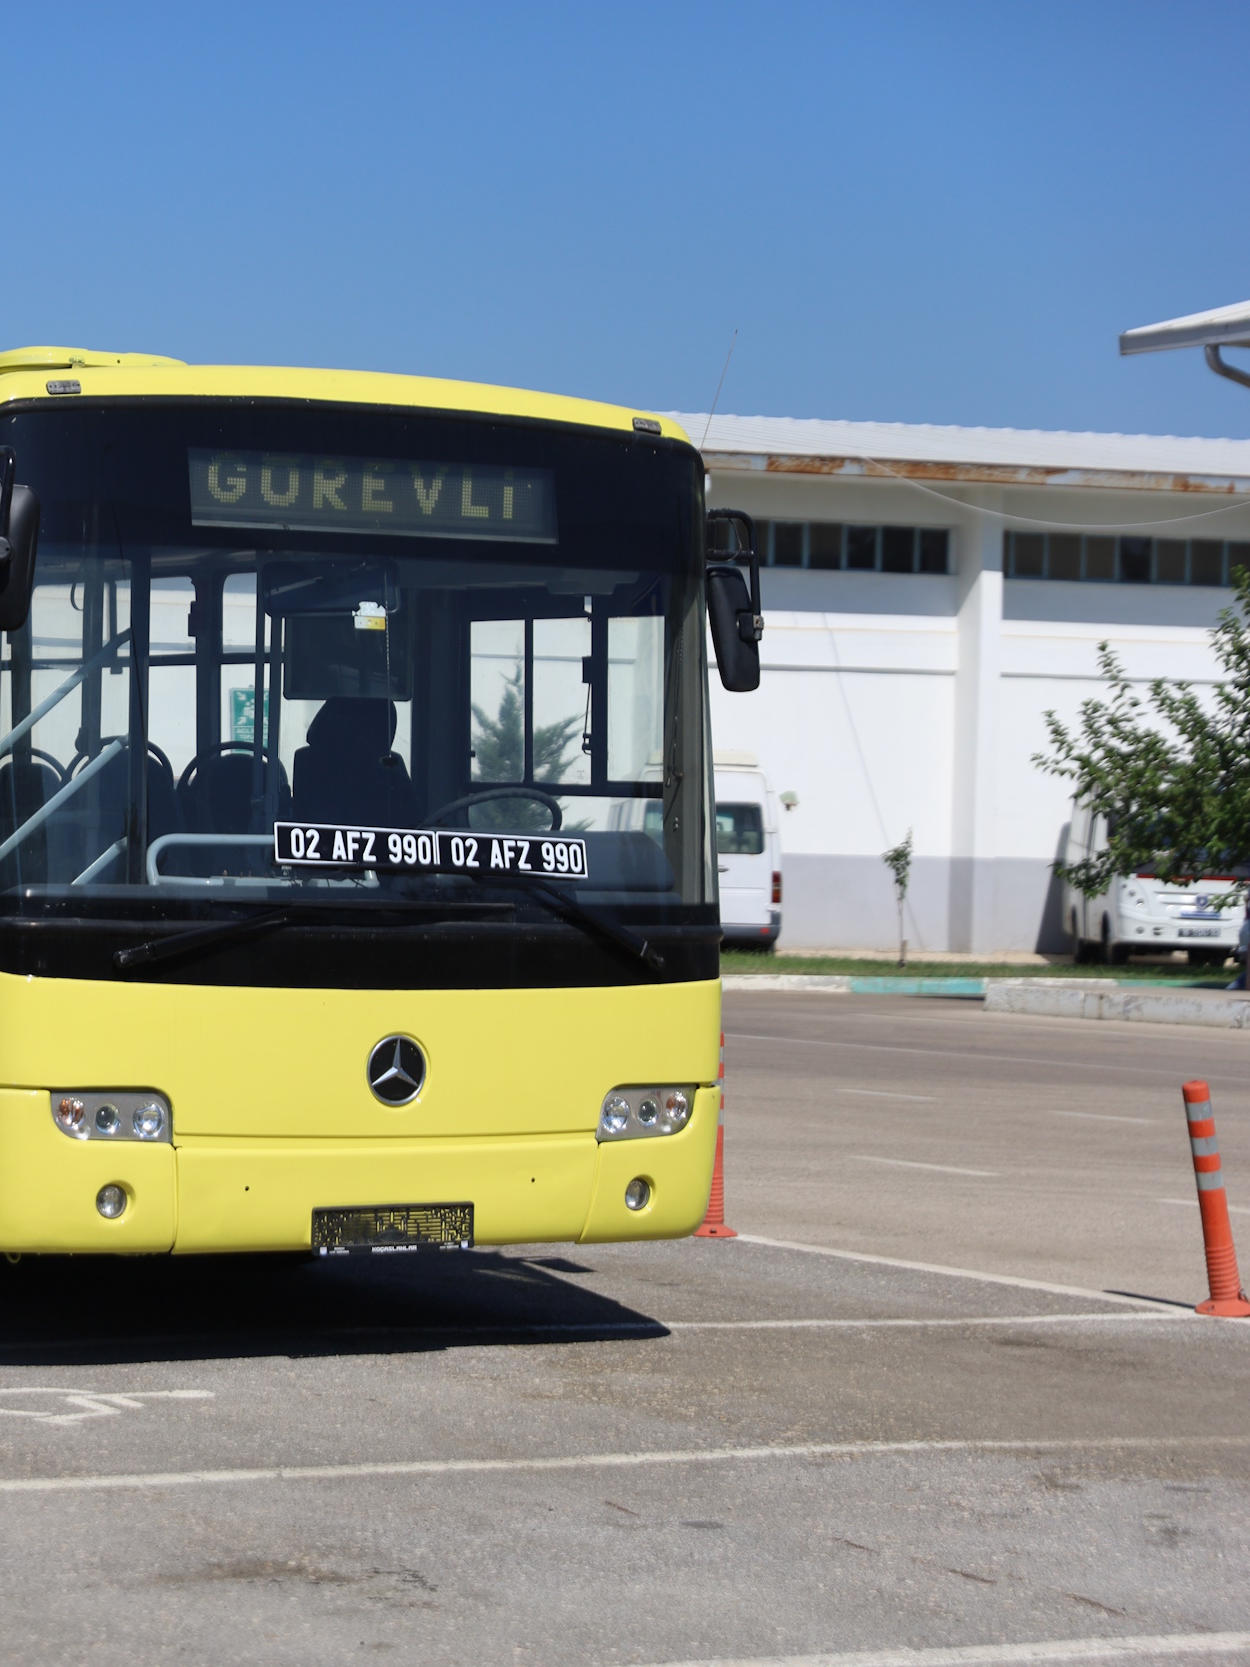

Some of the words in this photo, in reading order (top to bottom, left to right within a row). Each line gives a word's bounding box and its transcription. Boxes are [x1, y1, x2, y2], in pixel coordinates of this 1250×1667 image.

[290, 828, 321, 859] 02
[332, 830, 377, 862] AFZ
[387, 833, 432, 865] 990
[450, 836, 479, 868] 02
[490, 839, 532, 870] AFZ
[541, 842, 583, 873] 990
